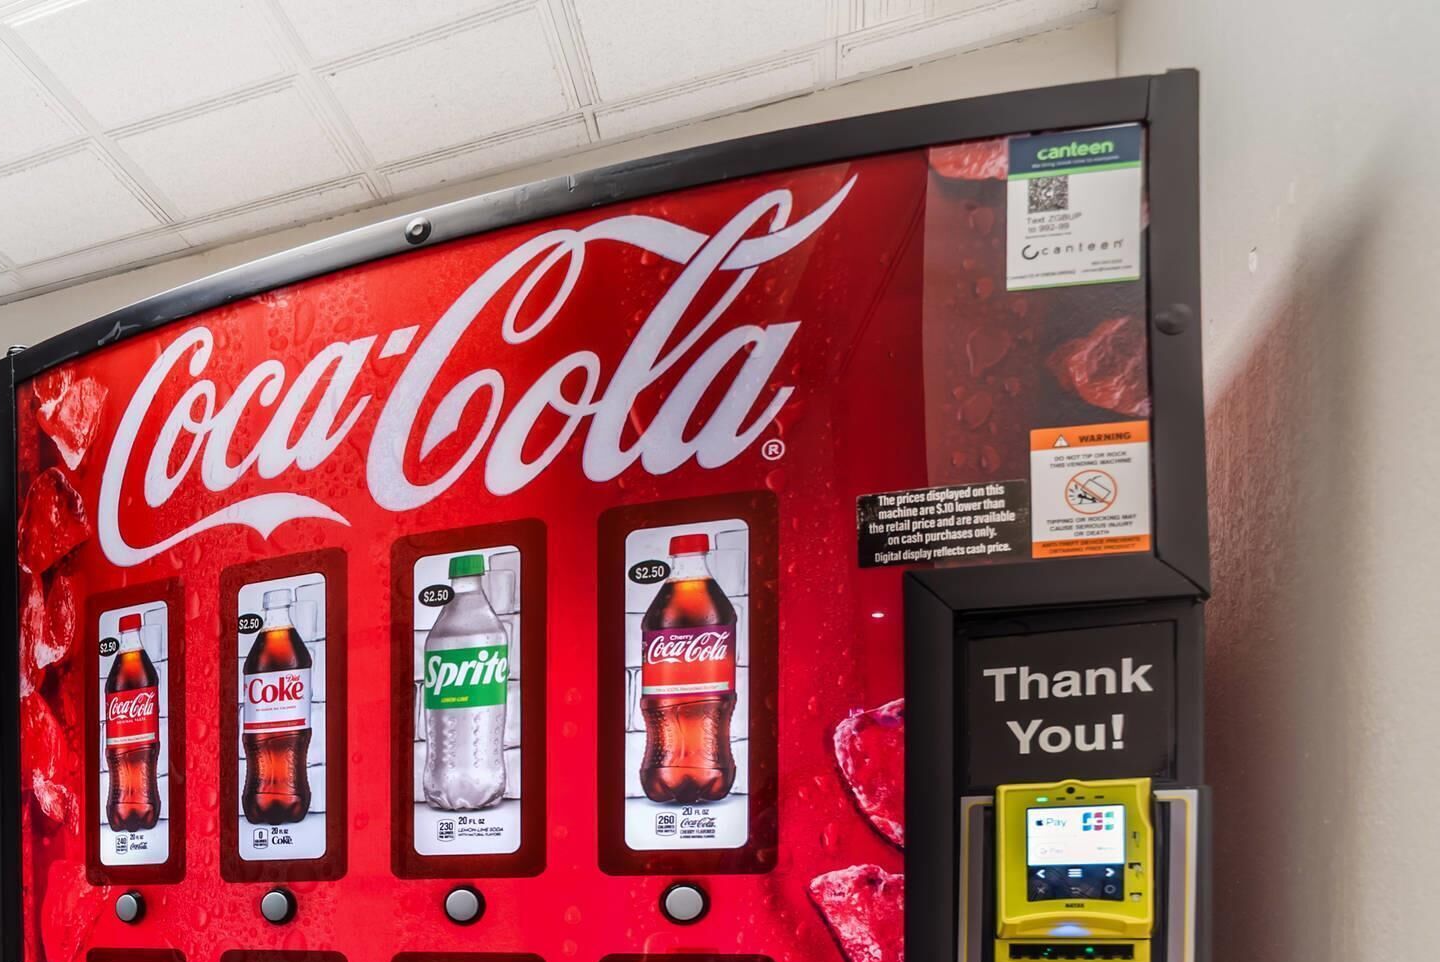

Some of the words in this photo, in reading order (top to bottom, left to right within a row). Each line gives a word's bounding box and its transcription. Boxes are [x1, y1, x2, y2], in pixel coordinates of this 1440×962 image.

[1037, 140, 1114, 161] canteen
[98, 174, 858, 566] Coca-Cola
[1079, 432, 1131, 443] WARNING
[878, 495, 895, 506] The
[896, 491, 925, 509] prices
[926, 486, 970, 503] displayed
[972, 487, 984, 496] on
[986, 484, 1004, 495] this
[878, 507, 918, 520] machine
[919, 506, 935, 516] are
[936, 502, 954, 514] $.10
[955, 500, 982, 512] lower
[983, 499, 1005, 509] than
[869, 523, 884, 534] the
[886, 519, 910, 532] retail
[912, 518, 935, 532] price
[937, 515, 954, 527] and
[956, 515, 971, 525] are
[973, 510, 1015, 524] available
[888, 535, 900, 545] on
[901, 531, 923, 544] cash
[925, 529, 973, 543] purchases
[975, 526, 997, 539] only.
[875, 550, 902, 564] Digital
[903, 547, 932, 561] display
[933, 546, 965, 557] reflects
[966, 544, 985, 554] cash
[987, 542, 1011, 554] price.
[635, 566, 664, 579] $2.50
[424, 589, 448, 602] $2.50
[239, 618, 259, 630] $2.50
[100, 641, 116, 653] $2.50
[648, 632, 730, 664] Coca-Cola
[424, 650, 508, 696] Sprite
[983, 658, 1153, 702] Thank
[248, 676, 304, 704] Coke
[109, 692, 155, 721] Coca-Cola
[1006, 714, 1124, 754] You!
[458, 816, 467, 824] 20
[658, 815, 674, 824] 260
[682, 807, 692, 815] 20
[440, 822, 453, 830] 230
[680, 817, 717, 828] Coca-Cola
[1046, 818, 1066, 828] Pay
[259, 831, 263, 839] 0
